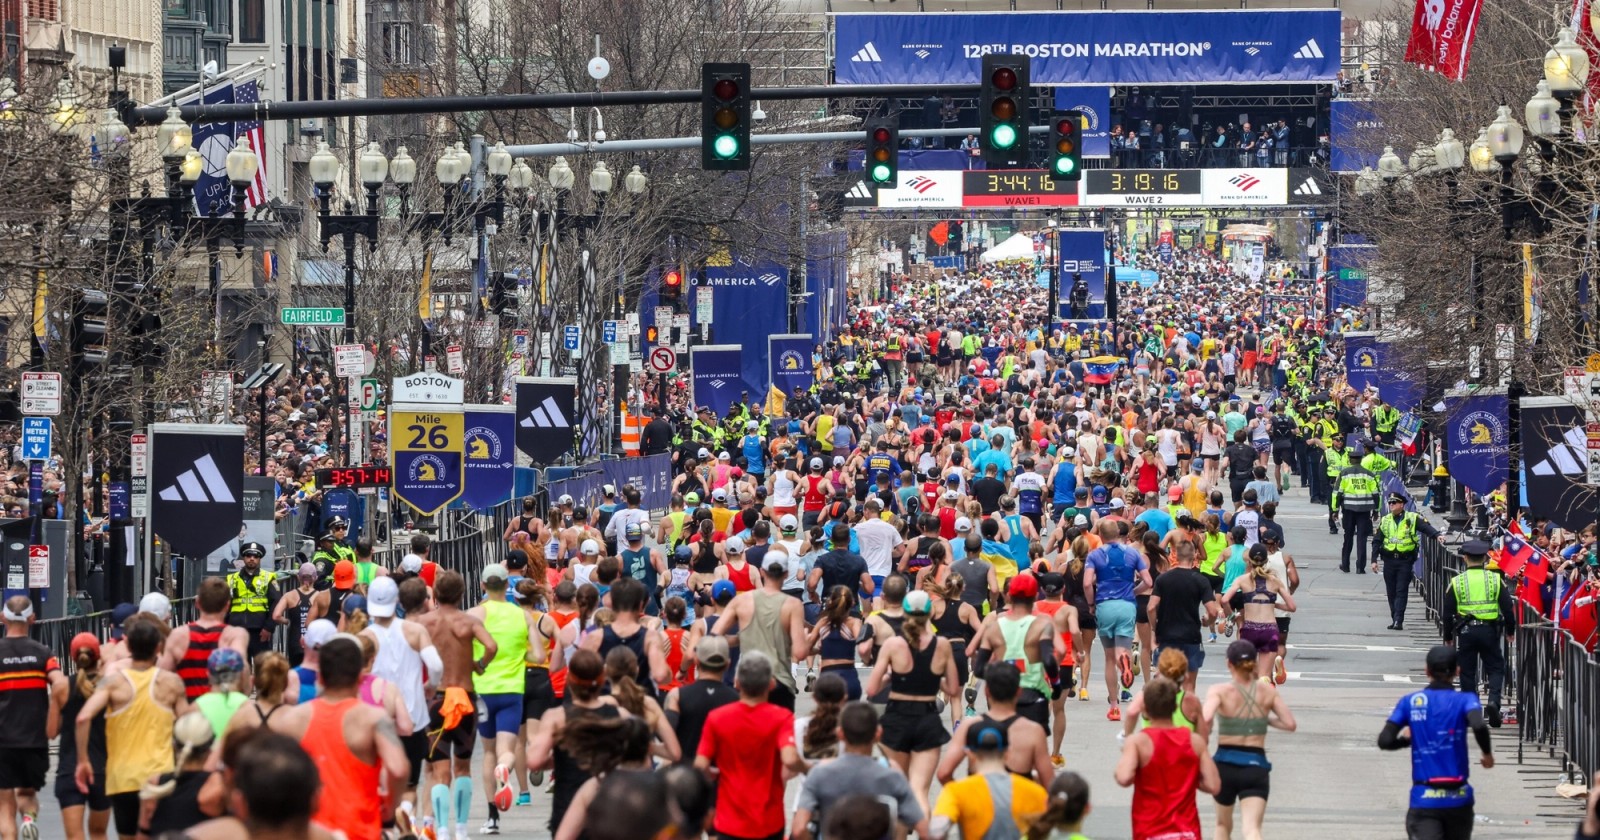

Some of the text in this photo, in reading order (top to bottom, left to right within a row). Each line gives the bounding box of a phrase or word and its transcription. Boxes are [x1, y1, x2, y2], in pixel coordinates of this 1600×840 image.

[1439, 0, 1464, 64] new balanc
[963, 44, 1006, 58] 128TH
[1012, 43, 1089, 58] BOSTON
[204, 178, 232, 197] UPLA
[988, 175, 1055, 192] 3:44:16
[1112, 174, 1178, 190] 3:19:16
[285, 310, 332, 322] FAIRFIELD
[405, 377, 452, 389] BOSTON
[364, 387, 372, 405] F
[415, 415, 440, 423] Mile
[1463, 413, 1481, 426] BOSTON
[407, 425, 448, 449] 26
[485, 429, 500, 457] MARATHON
[412, 456, 428, 467] BOSTON
[430, 456, 444, 478] MARATHON
[3, 656, 37, 664] OUTLIERS
